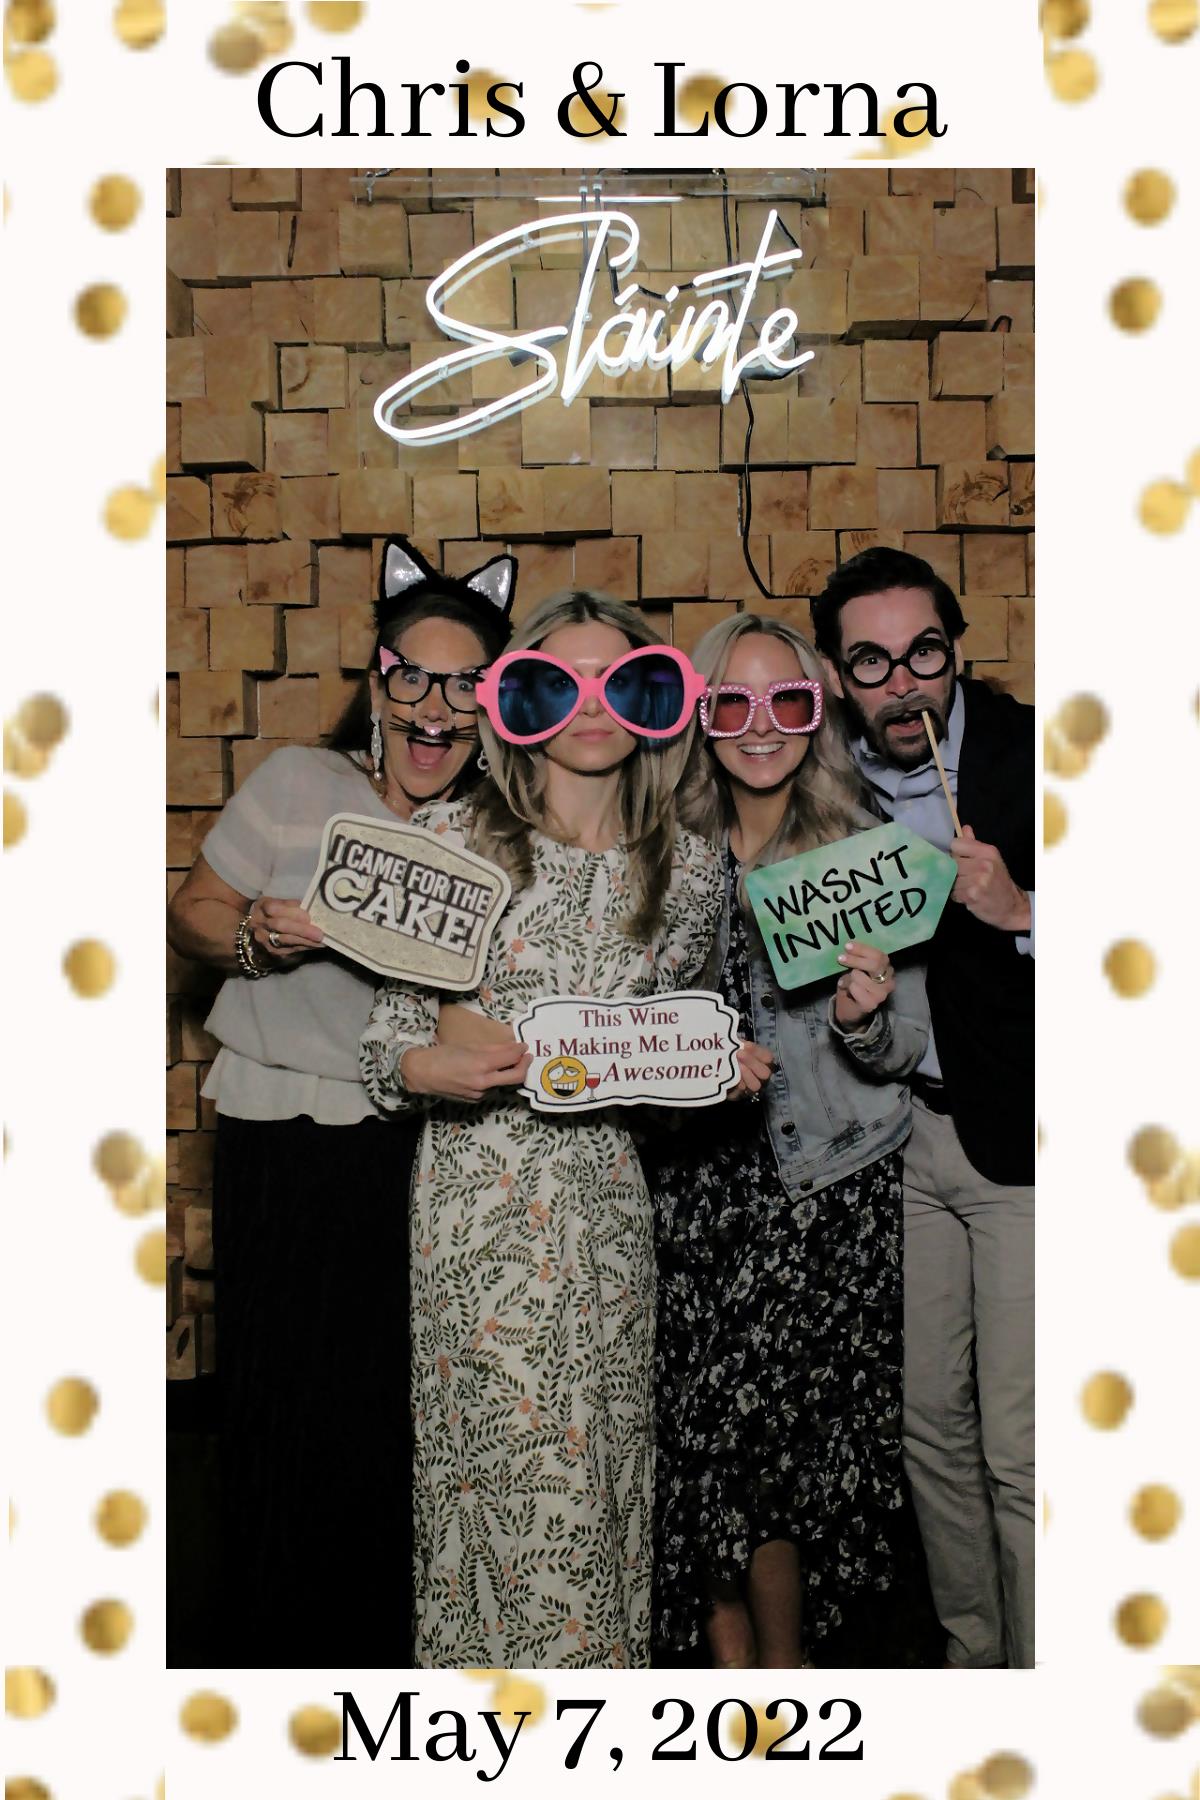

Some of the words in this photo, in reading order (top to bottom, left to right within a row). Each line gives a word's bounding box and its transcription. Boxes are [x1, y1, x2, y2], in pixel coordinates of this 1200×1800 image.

[374, 209, 815, 441] Sláinte
[319, 864, 485, 958] CAKE!
[329, 834, 345, 864] I
[347, 840, 407, 882] CAME
[406, 860, 450, 899] FOR
[450, 875, 493, 914] THE
[764, 845, 908, 924] WASN'T
[773, 888, 927, 963] INVITED
[535, 1039, 551, 1057] Is
[558, 1036, 632, 1059] Making
[639, 1034, 670, 1053] Me
[675, 1032, 725, 1051] Look
[579, 1008, 622, 1028] This
[629, 1007, 680, 1026] Wine
[603, 1057, 723, 1083] Awesome!
